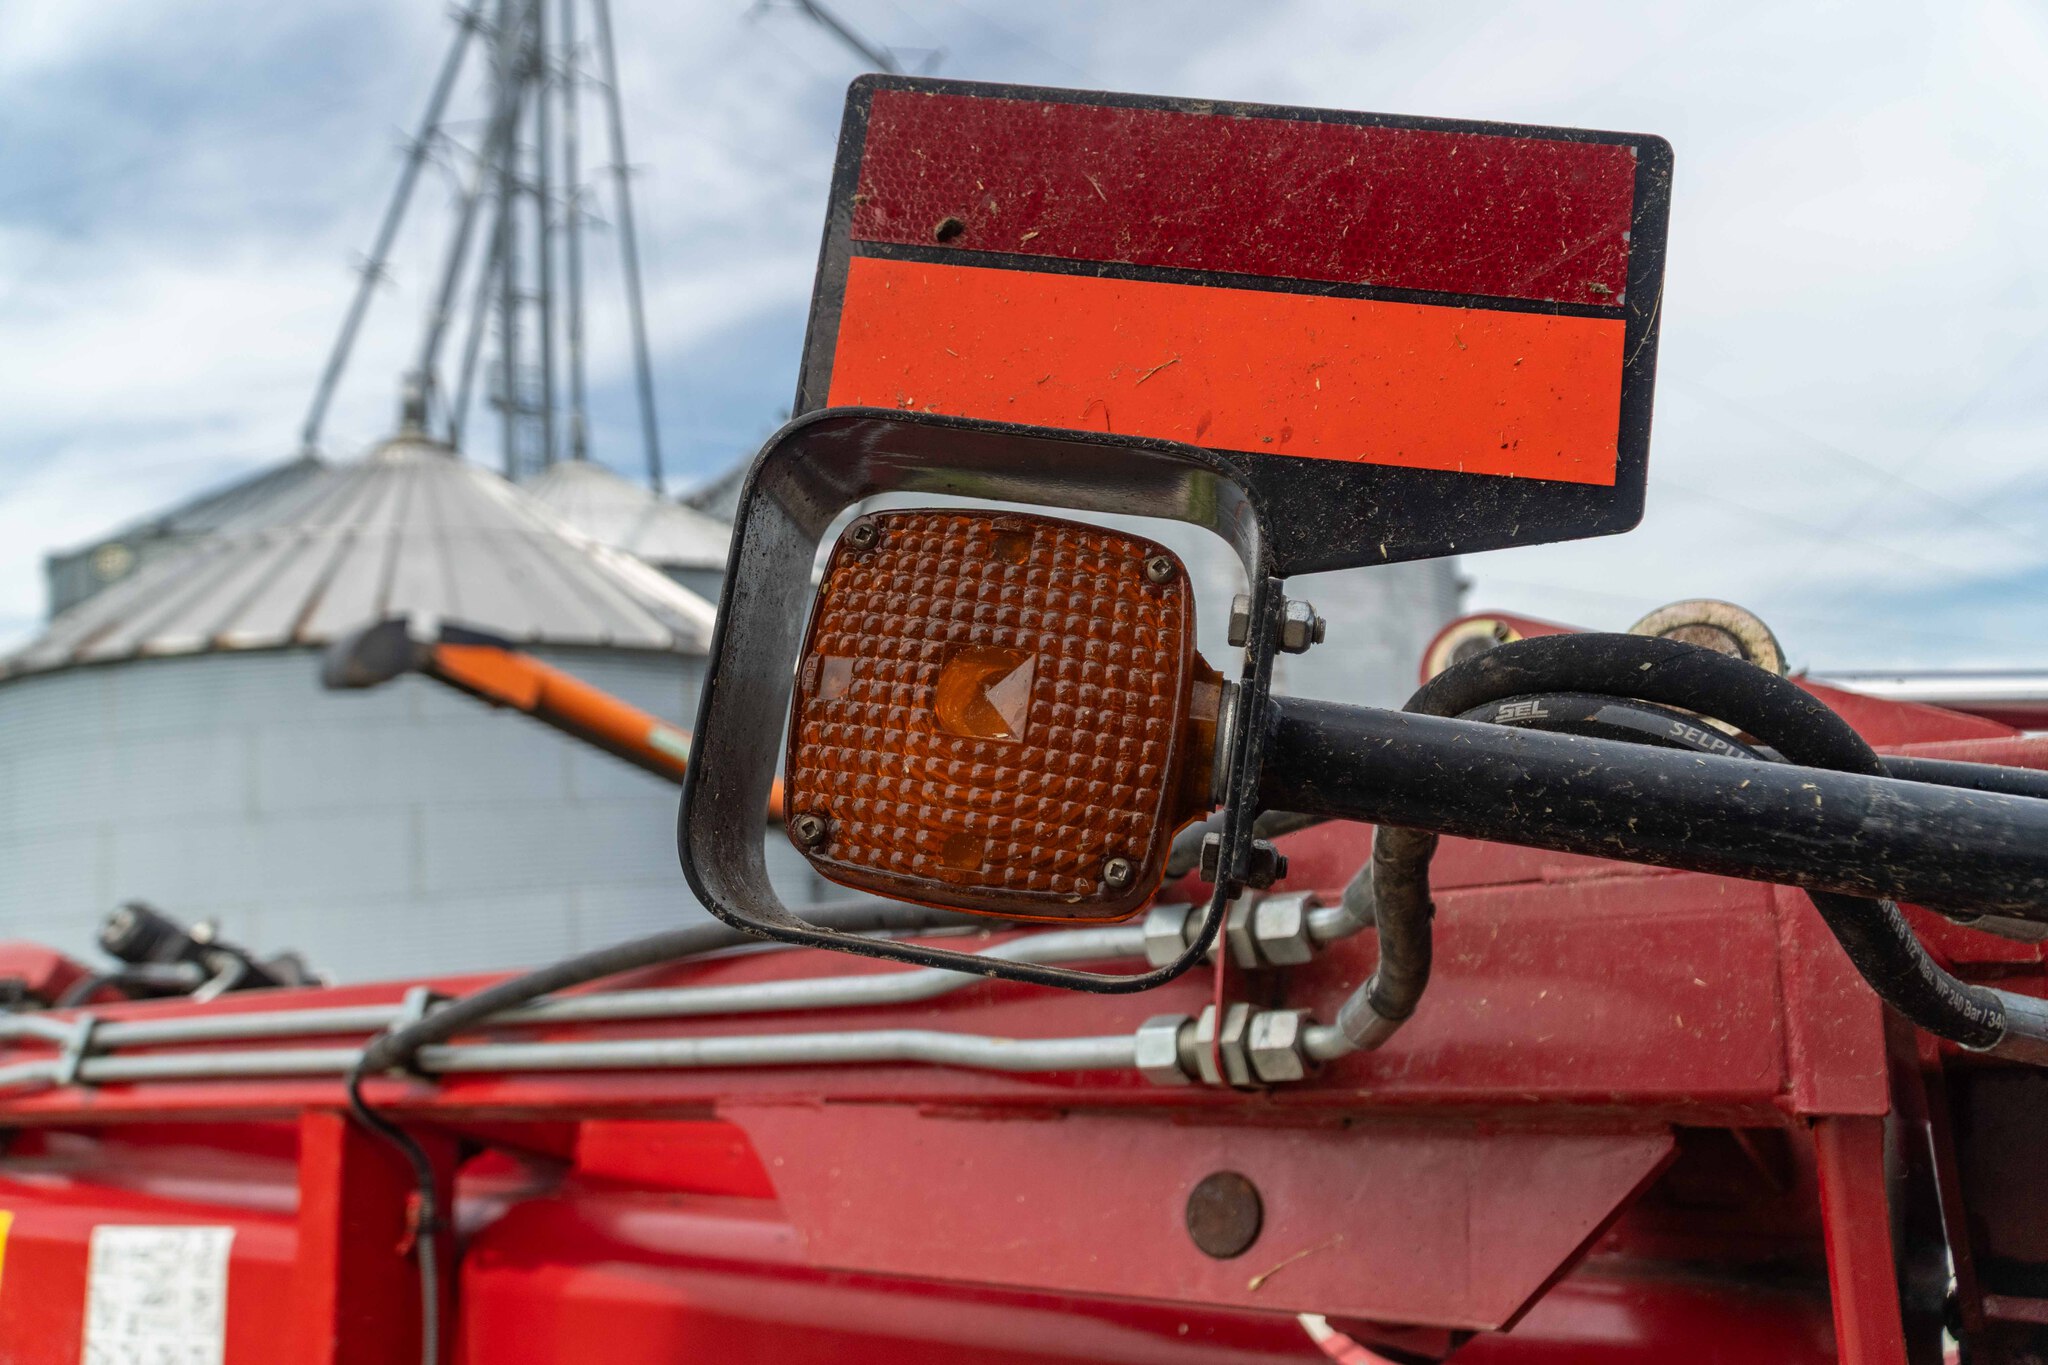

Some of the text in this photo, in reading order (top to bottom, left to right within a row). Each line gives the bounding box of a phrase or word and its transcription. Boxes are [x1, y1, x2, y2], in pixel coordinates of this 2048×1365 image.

[1496, 701, 1549, 723] SEL
[1948, 989, 1964, 1011] 240
[1963, 999, 1982, 1022] Bar
